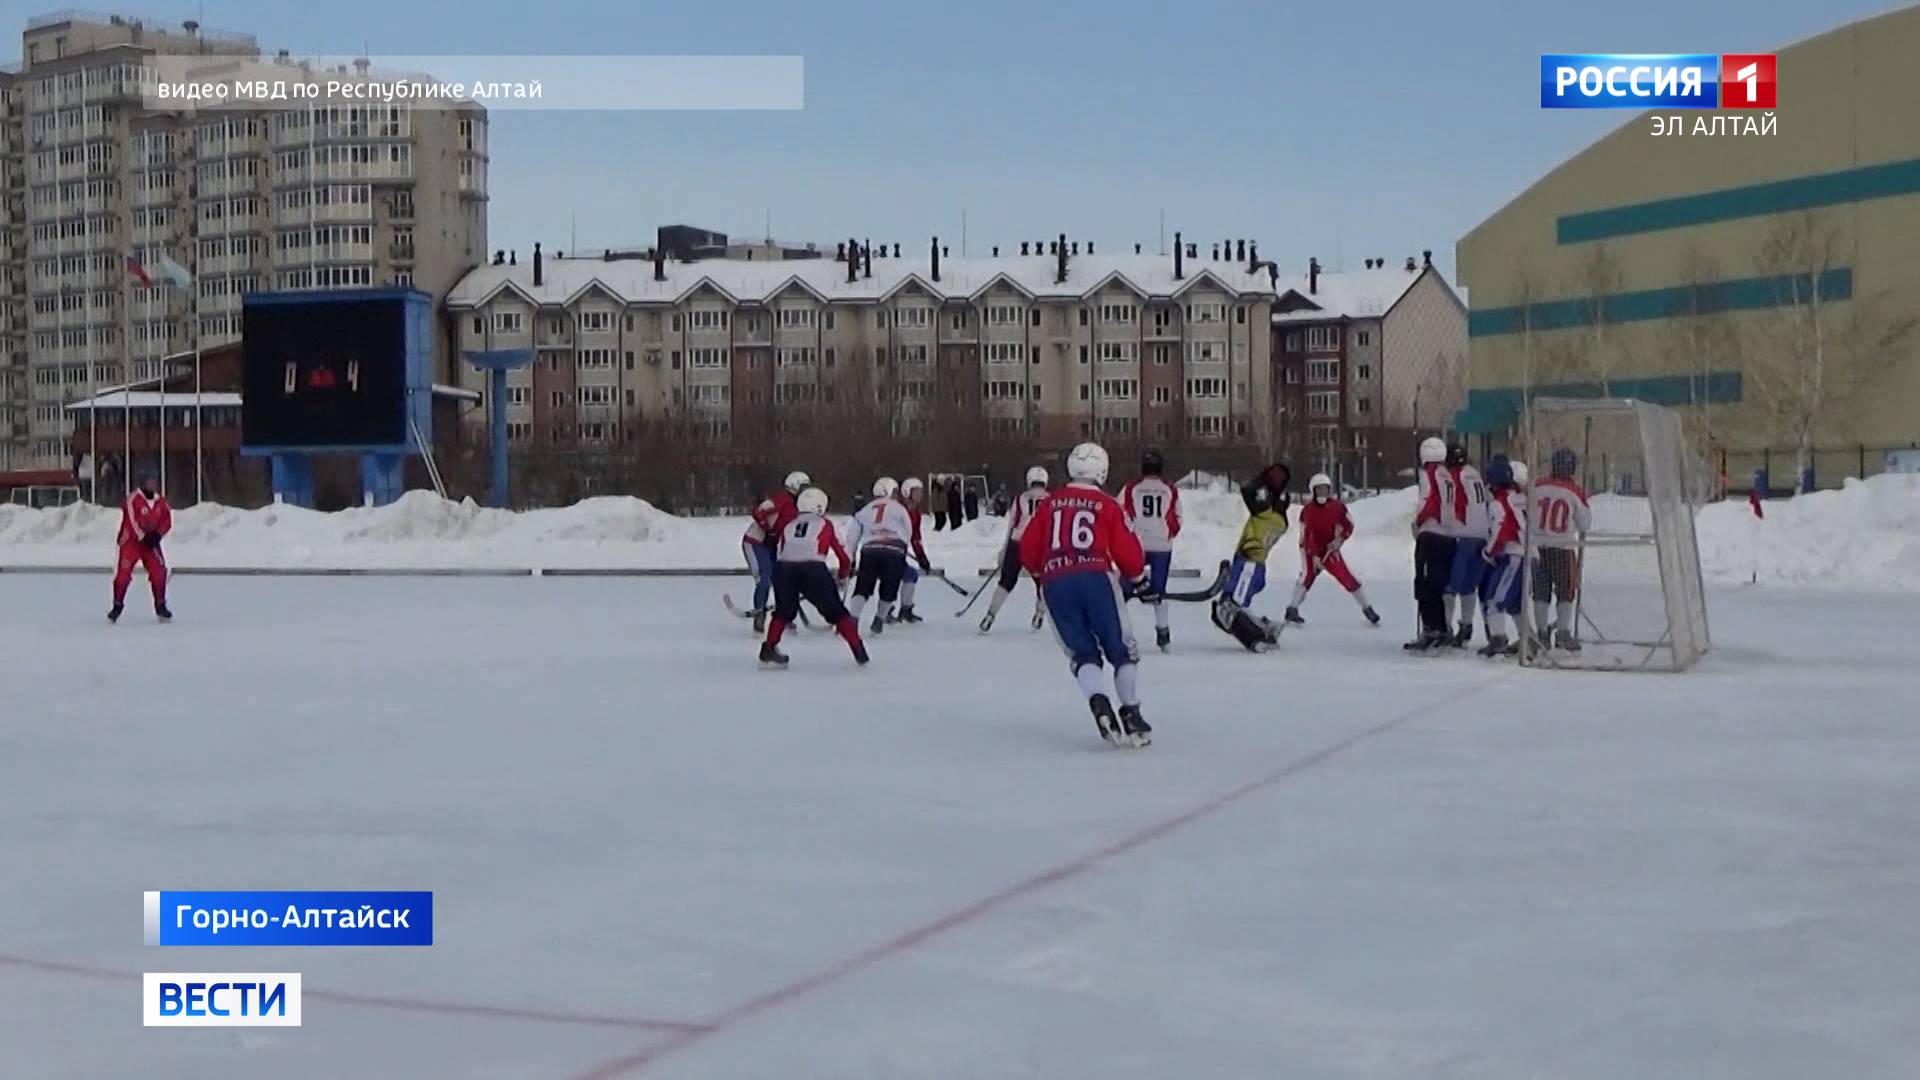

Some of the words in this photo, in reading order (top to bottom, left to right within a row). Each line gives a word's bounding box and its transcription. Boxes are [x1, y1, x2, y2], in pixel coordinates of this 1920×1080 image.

[872, 503, 887, 524] 7
[1142, 495, 1163, 518] 91
[1538, 497, 1569, 533] 10
[1051, 510, 1096, 549] 16
